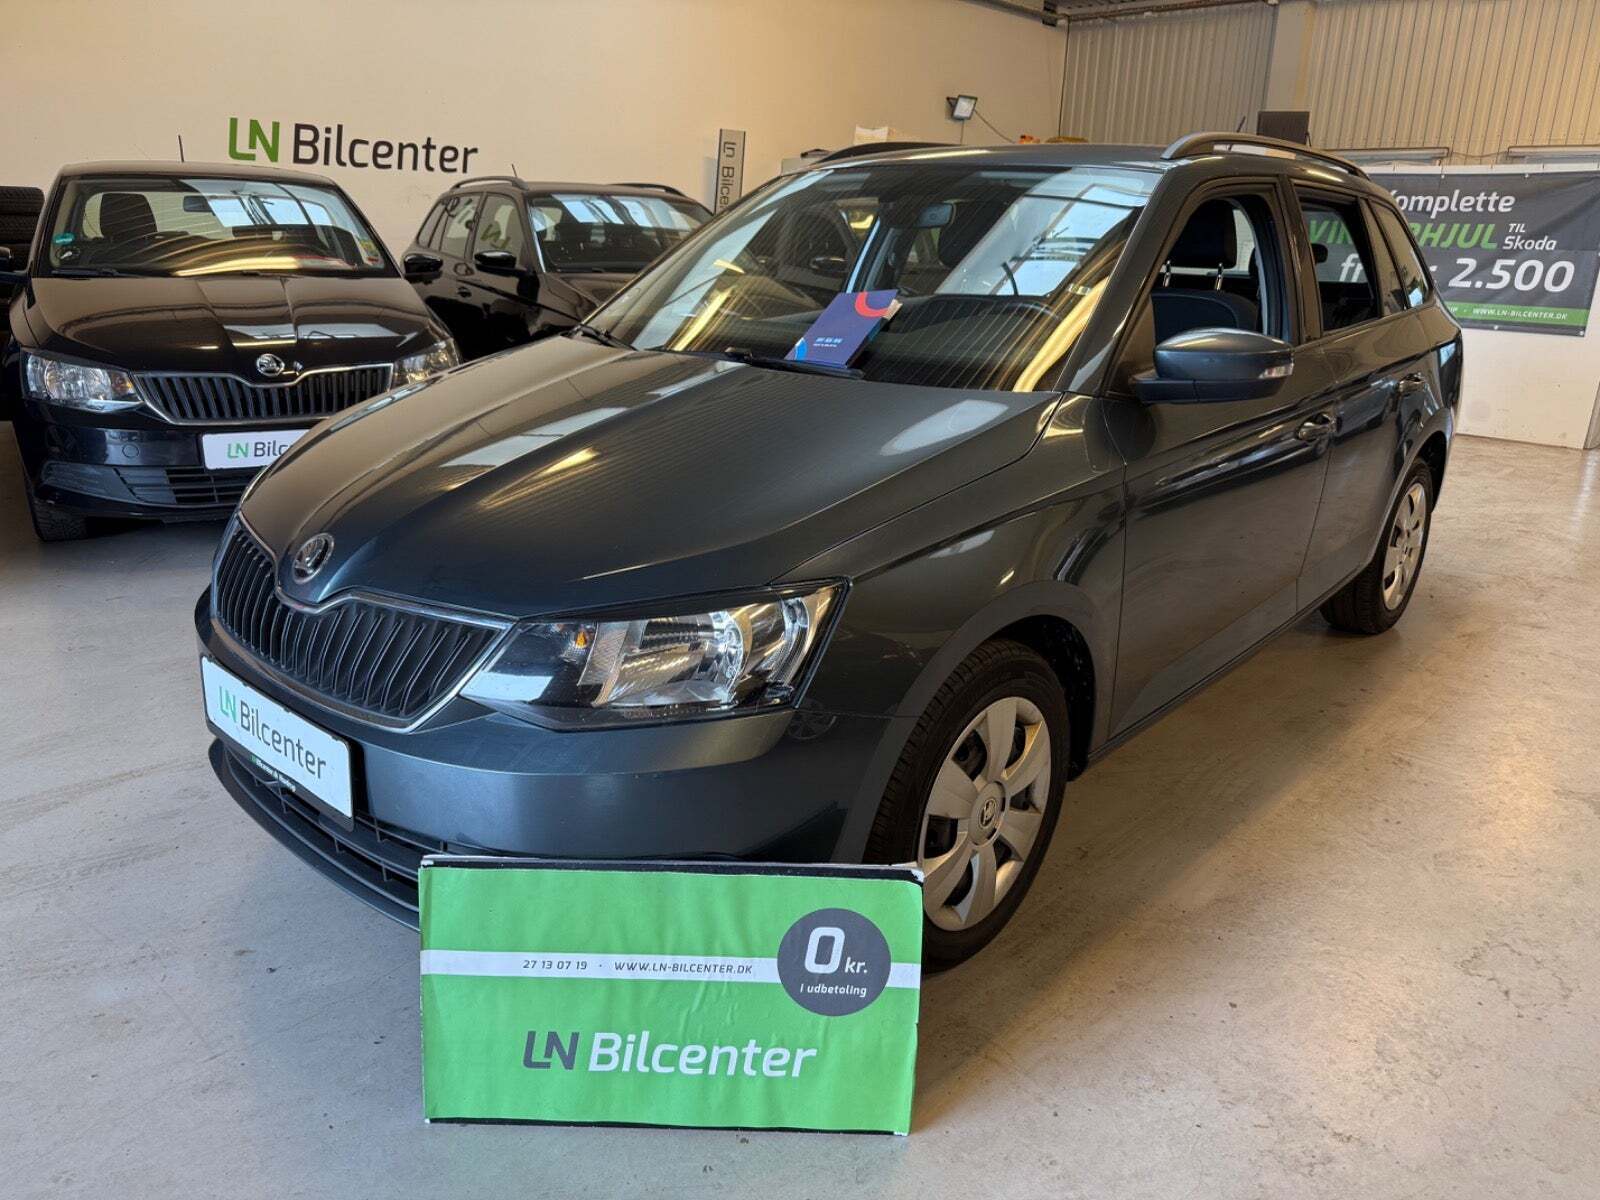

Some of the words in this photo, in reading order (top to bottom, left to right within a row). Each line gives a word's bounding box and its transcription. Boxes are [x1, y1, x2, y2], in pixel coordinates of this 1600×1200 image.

[228, 117, 281, 163] LN
[292, 123, 479, 174] Bilcenter
[1508, 223, 1526, 233] TIL
[1502, 235, 1558, 251] Skoda
[1448, 257, 1575, 293] 2.500
[1472, 307, 1568, 320] WWW.LN-BILCENTER.DK
[226, 443, 249, 459] LN
[218, 685, 237, 724] LN
[240, 699, 327, 780] Bilcenter
[804, 926, 845, 974] 0
[844, 957, 868, 974] kr.
[522, 959, 537, 969] 27
[541, 960, 552, 970] 13
[556, 961, 572, 970] 07
[576, 961, 588, 970] 19
[614, 961, 753, 975] WWW.LN-BILCENTER.DK
[807, 983, 867, 998] udbetaling
[522, 1030, 580, 1071] LN
[588, 1030, 818, 1079] Bilcenter
